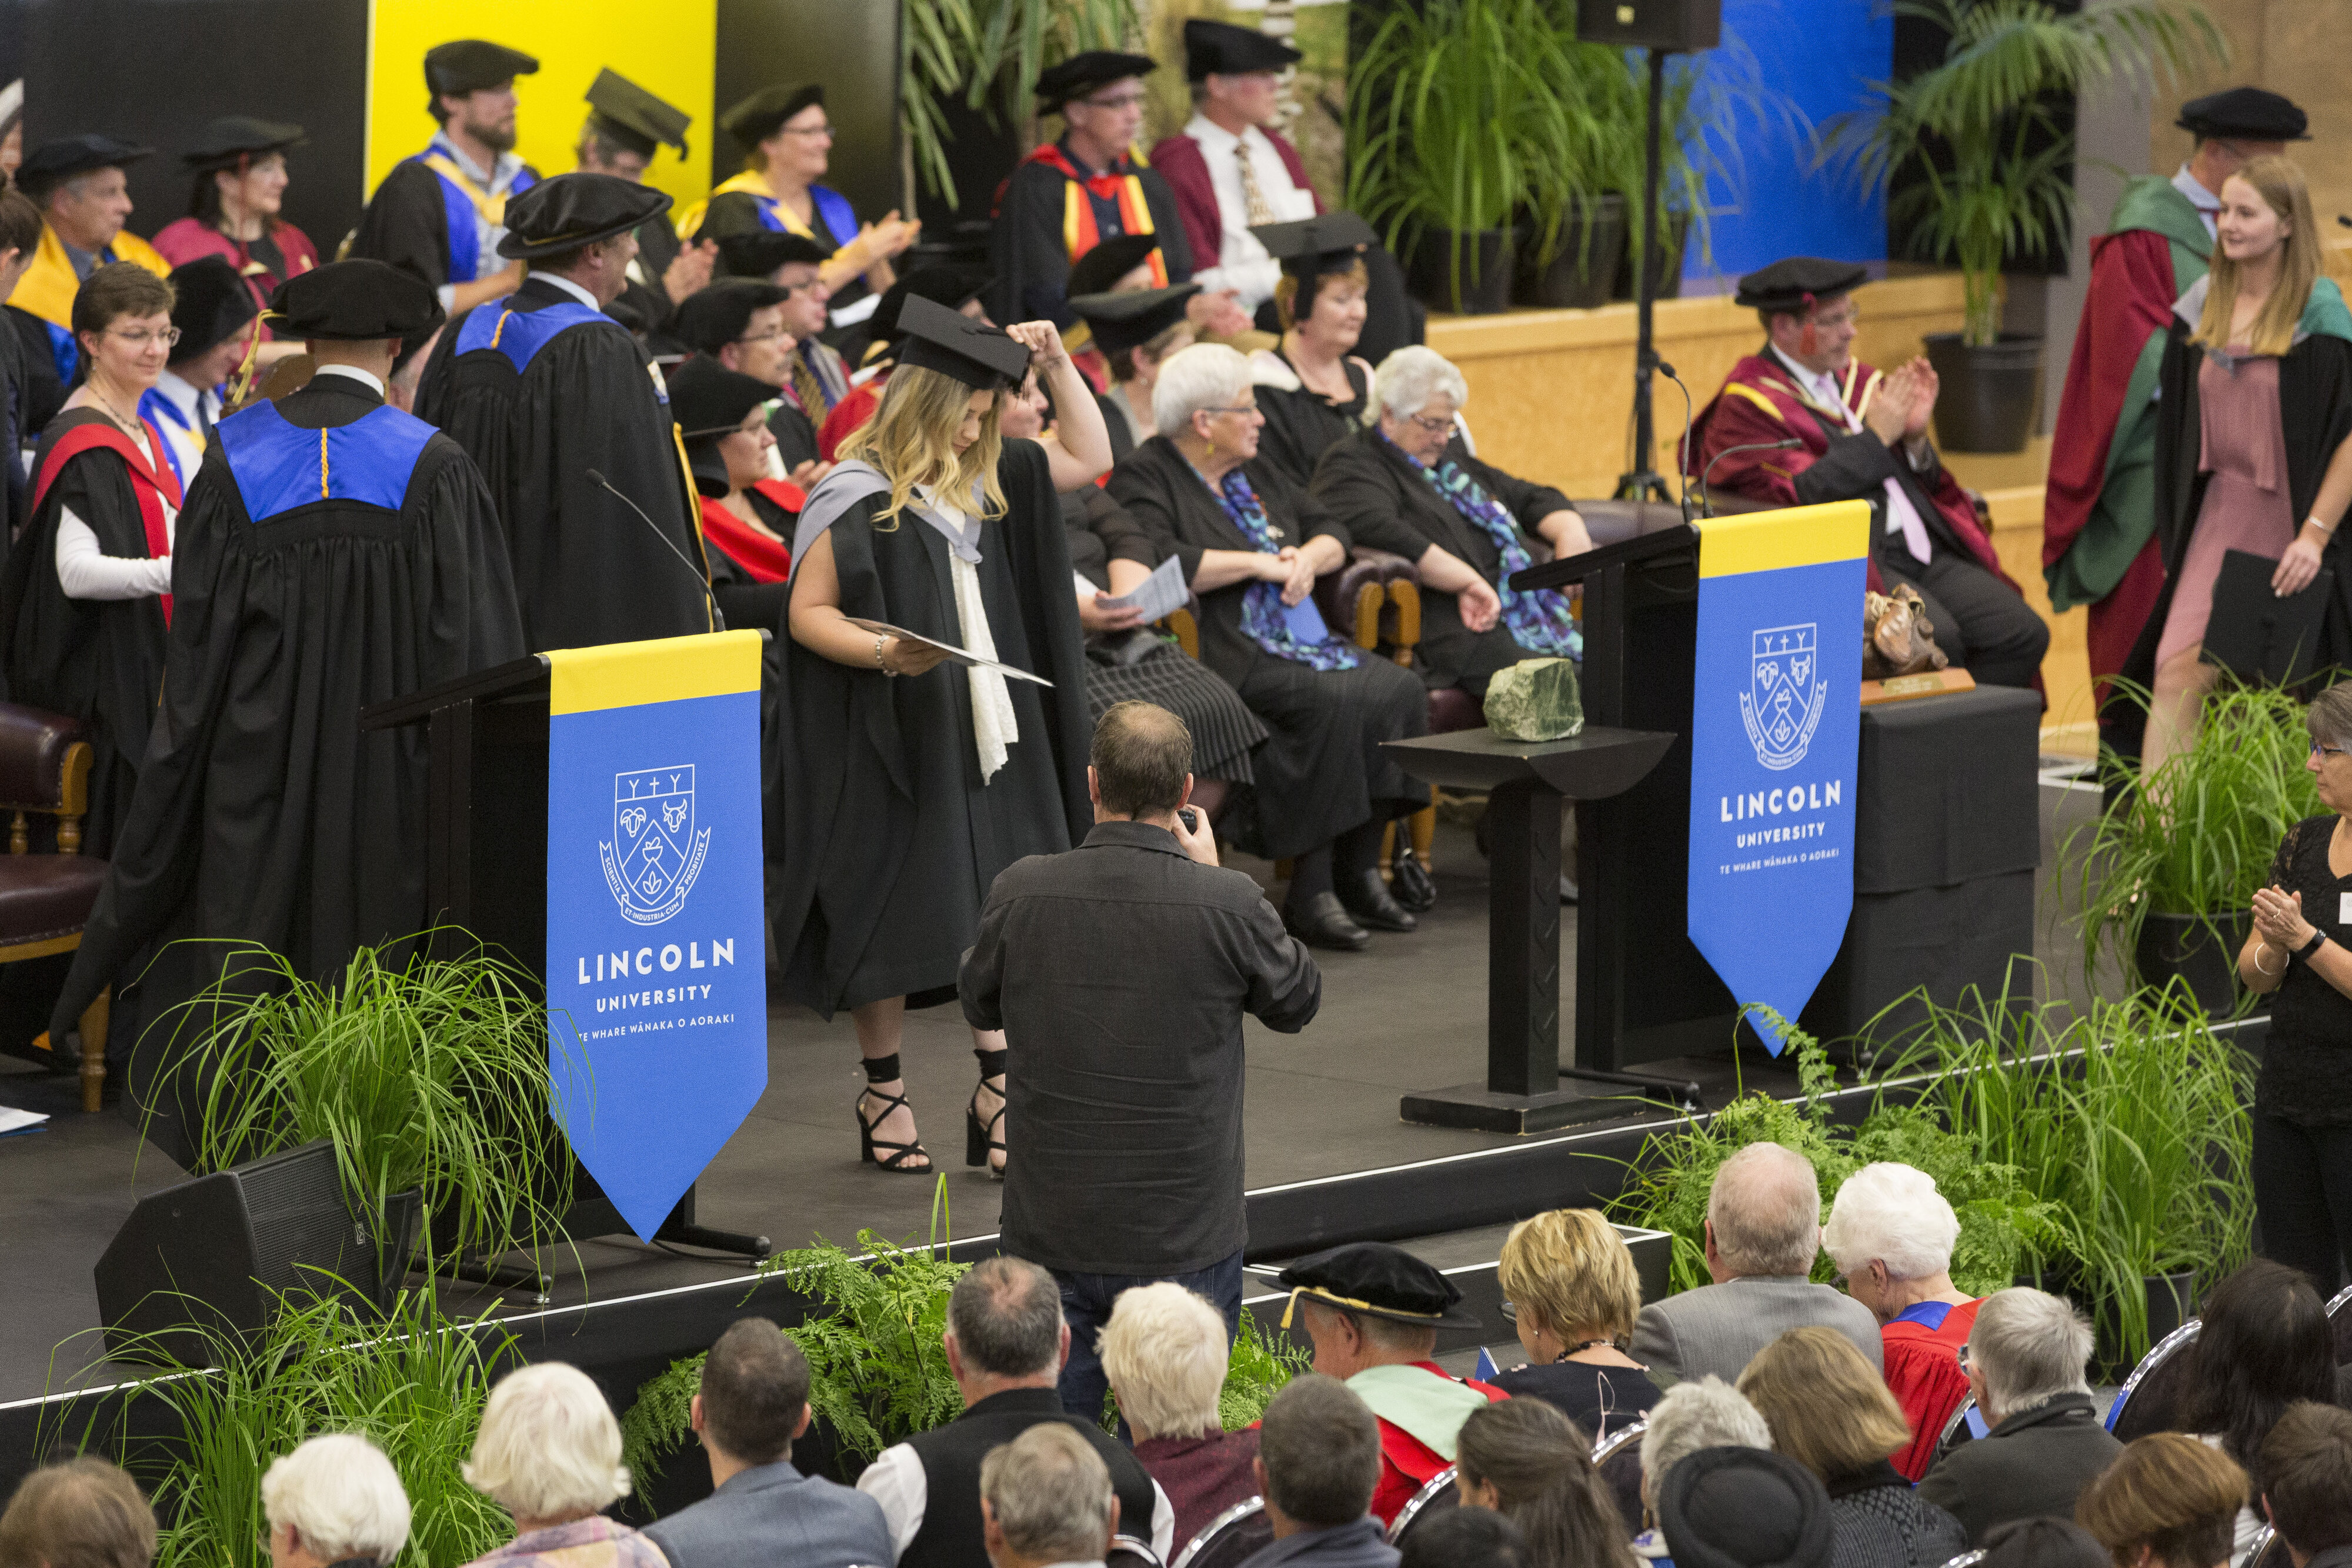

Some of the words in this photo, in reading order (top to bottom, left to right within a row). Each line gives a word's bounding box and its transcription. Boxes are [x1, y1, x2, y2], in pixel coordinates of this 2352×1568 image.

[1721, 779, 1841, 822] LINCOLN
[1737, 821, 1825, 848] UNIVERSITY
[605, 856, 620, 893] SCIENTIA
[684, 842, 705, 885] PROBITATE
[1720, 865, 1730, 875] TE
[1733, 859, 1761, 872] WHARE
[1800, 852, 1807, 862] O
[1809, 848, 1840, 861] AORAKI
[579, 938, 734, 985] LINCOLN
[596, 984, 712, 1012] UNIVERSITY
[592, 1026, 626, 1039] WHARE
[678, 1018, 686, 1027] O
[689, 1013, 735, 1026] AORAKI
